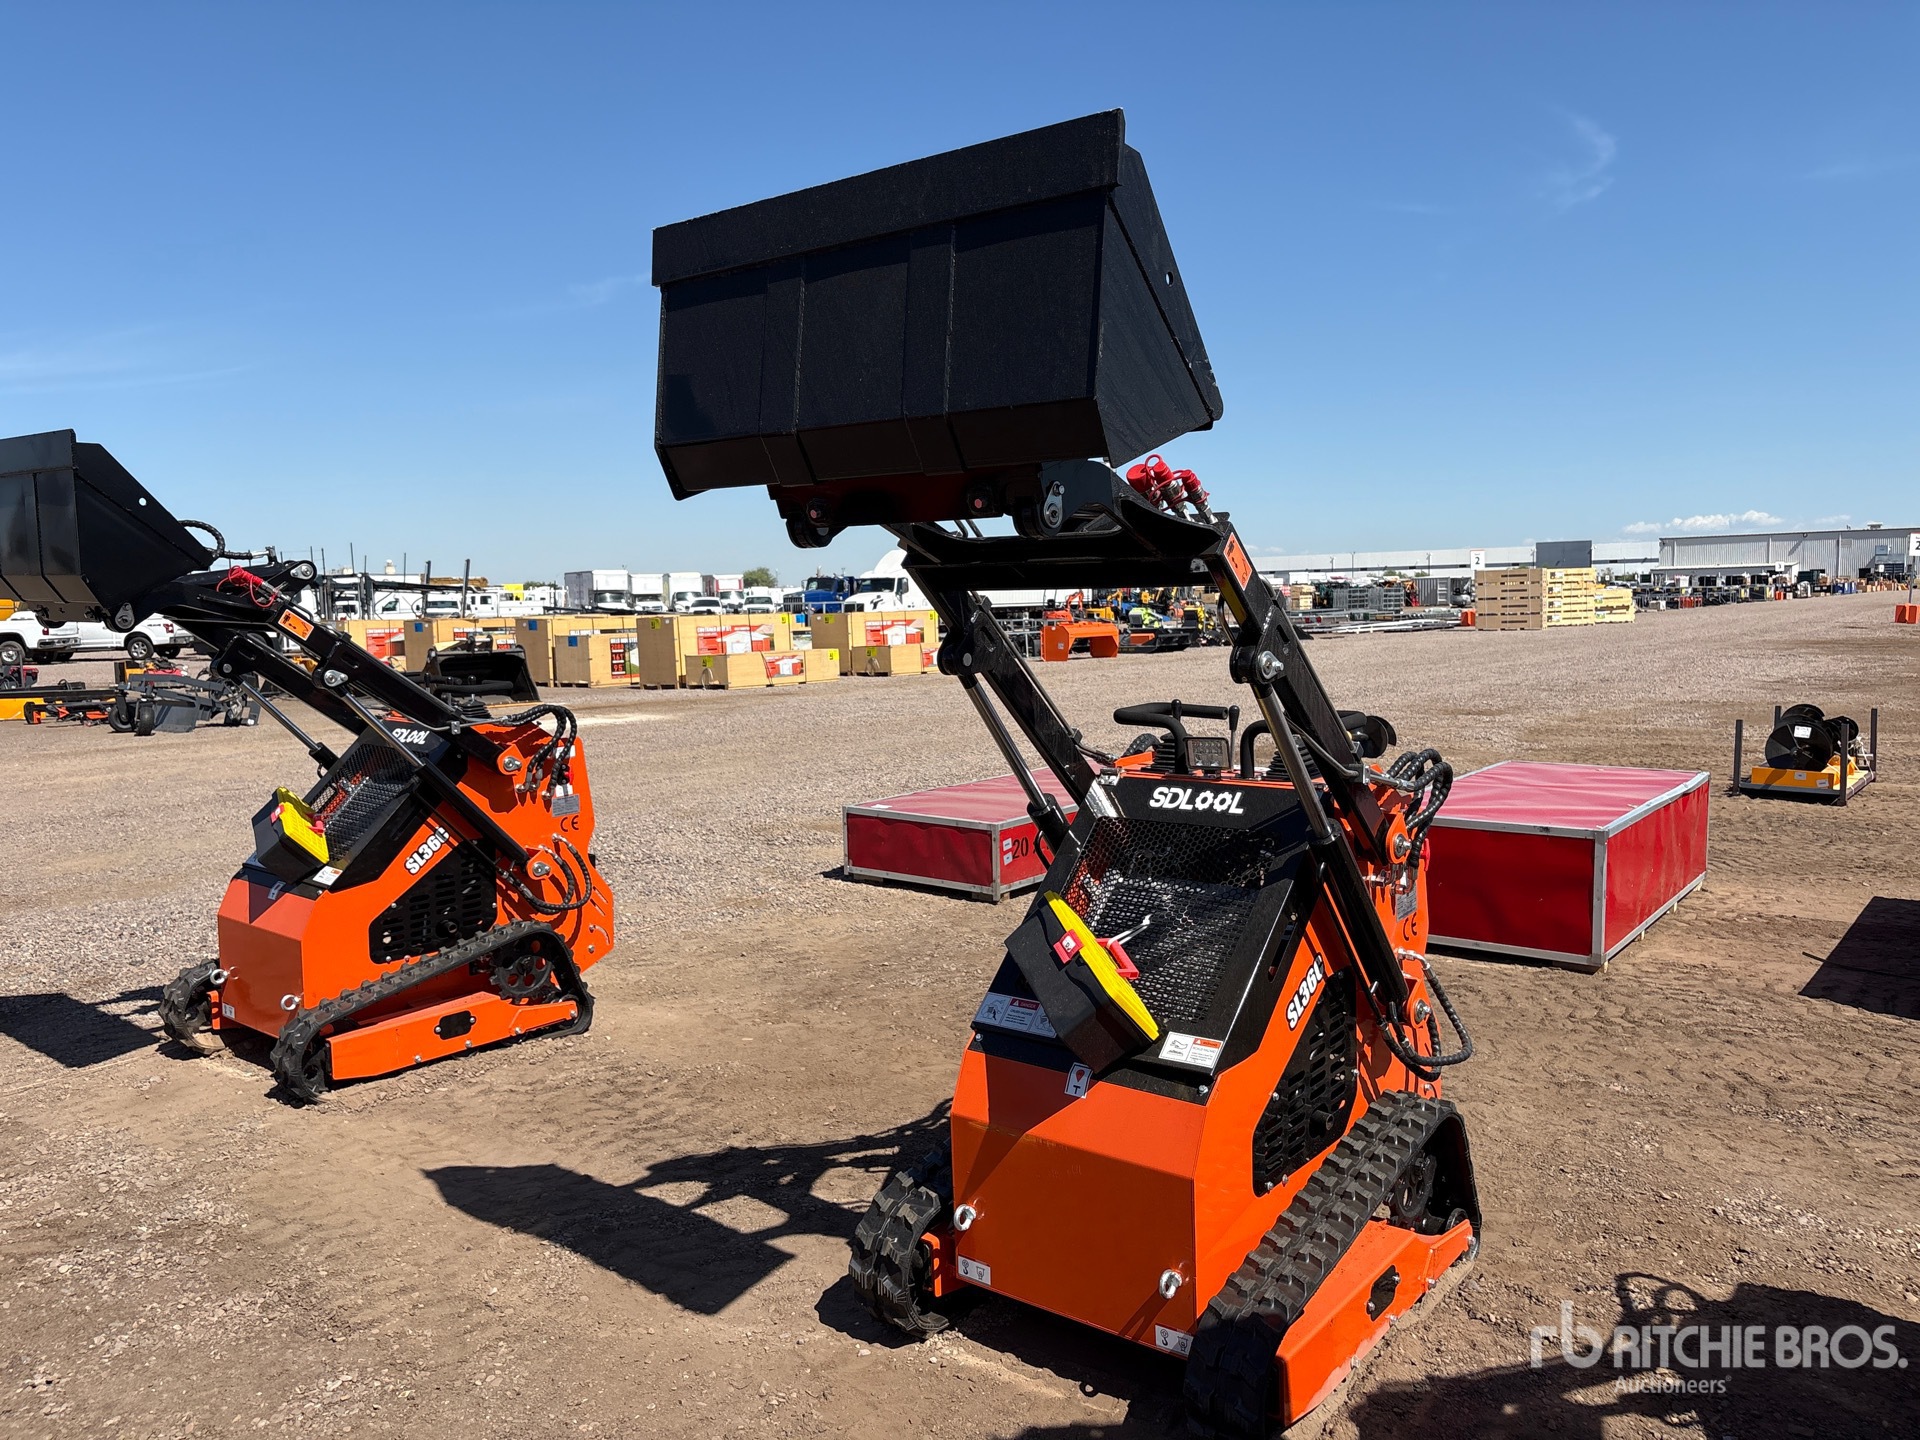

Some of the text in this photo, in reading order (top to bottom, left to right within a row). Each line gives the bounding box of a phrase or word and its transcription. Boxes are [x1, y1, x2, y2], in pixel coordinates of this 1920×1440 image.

[1474, 556, 1481, 565] 2
[1149, 786, 1244, 815] SDLOOL
[404, 826, 450, 875] SL36C
[1012, 836, 1029, 860] 20
[1072, 1084, 1081, 1095] T
